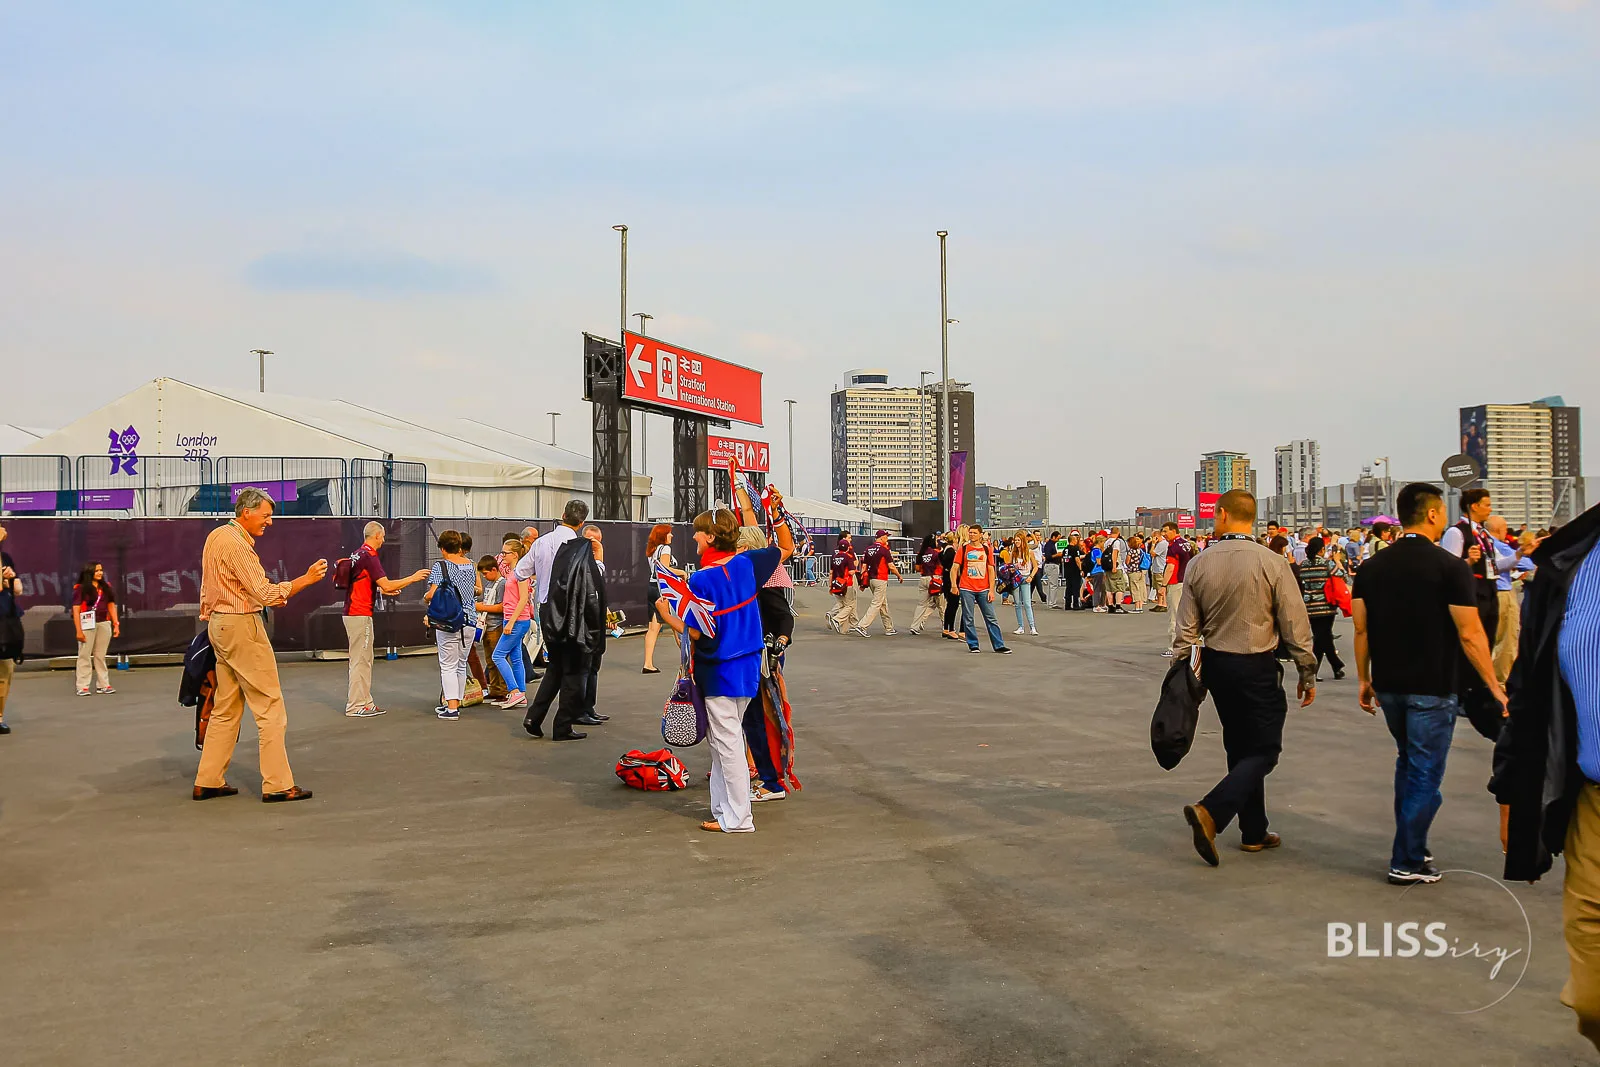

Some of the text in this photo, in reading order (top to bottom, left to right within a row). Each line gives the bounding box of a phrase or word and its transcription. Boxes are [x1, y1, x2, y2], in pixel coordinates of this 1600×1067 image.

[679, 374, 706, 392] Stratford
[680, 389, 736, 413] International Station
[176, 432, 218, 447] London
[183, 448, 209, 462] 2012
